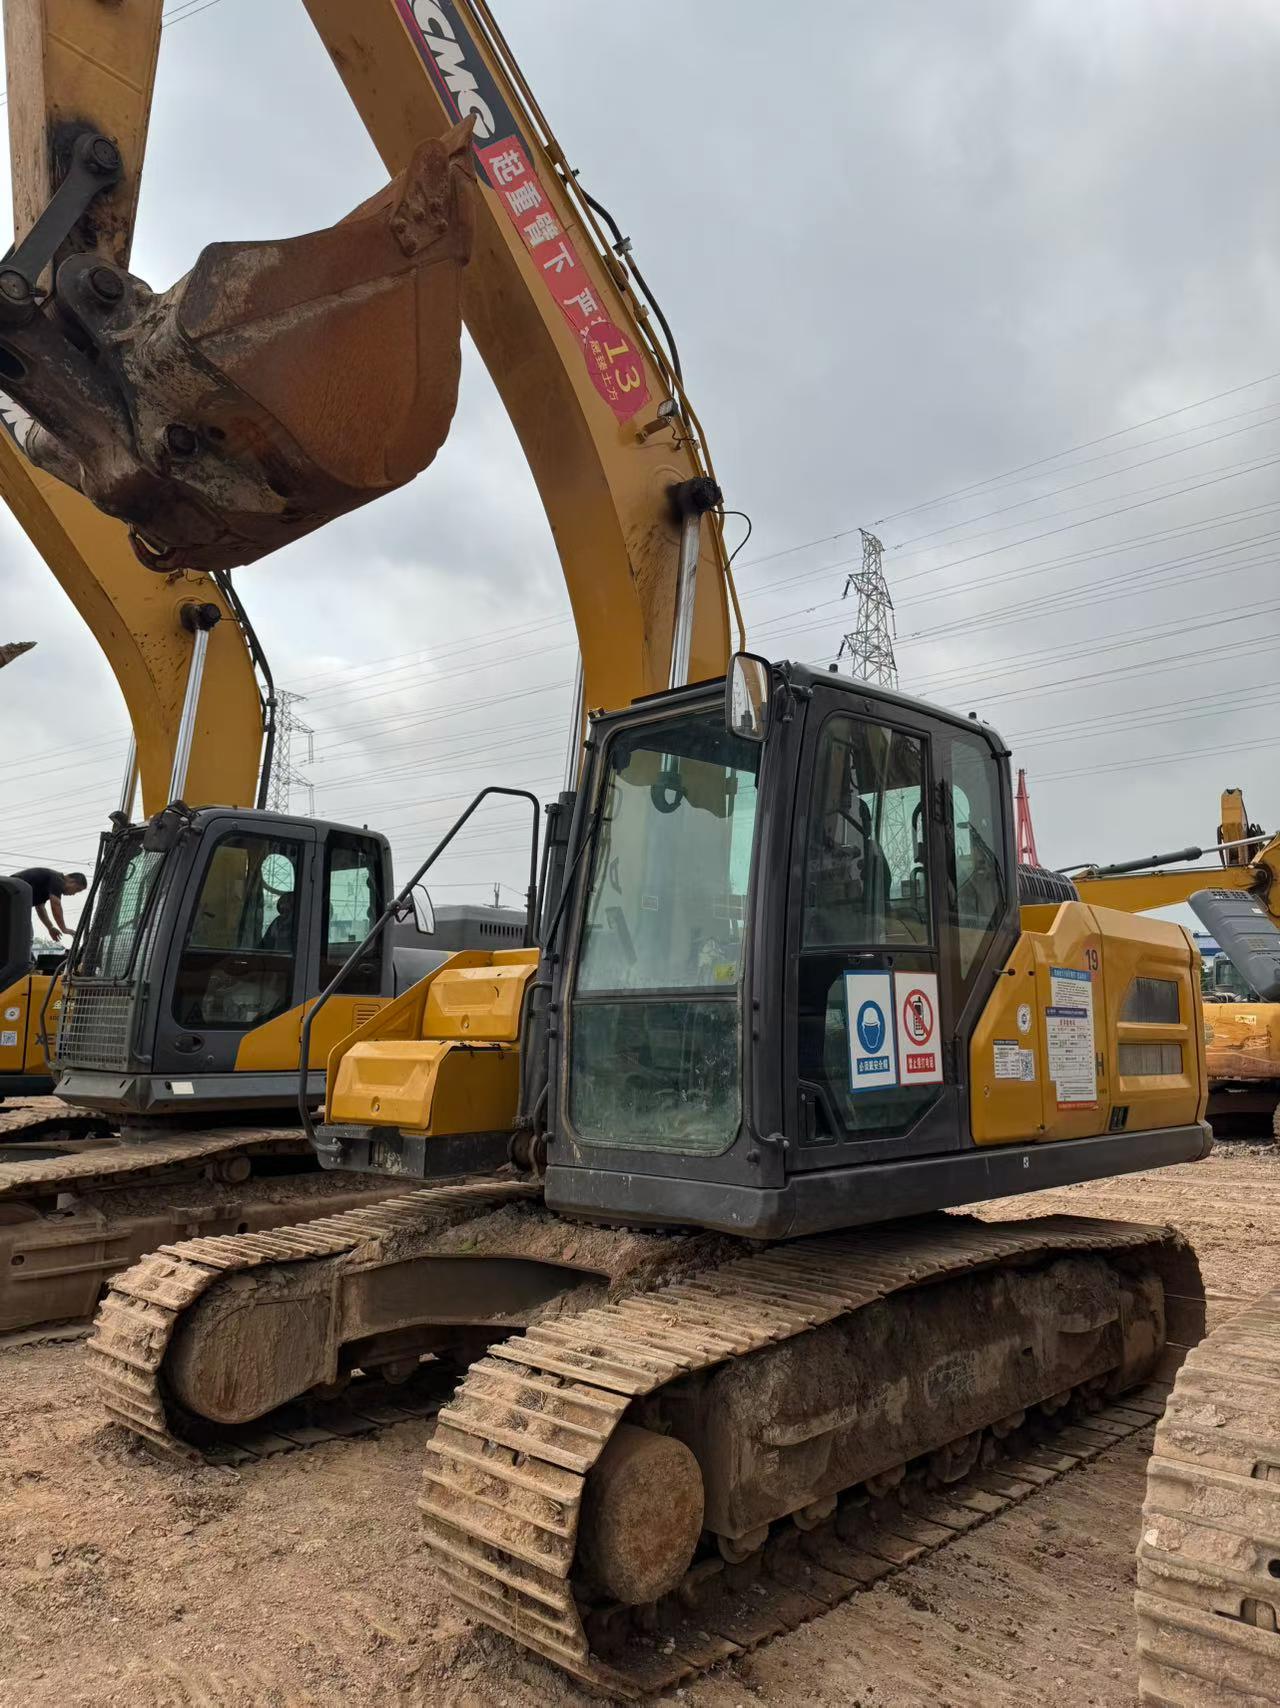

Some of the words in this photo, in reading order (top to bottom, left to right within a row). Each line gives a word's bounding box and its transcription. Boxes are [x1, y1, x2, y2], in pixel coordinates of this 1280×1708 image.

[408, 0, 496, 139] CMG
[488, 150, 575, 273] 起重臂下
[603, 339, 641, 393] 13
[1085, 949, 1099, 971] 19
